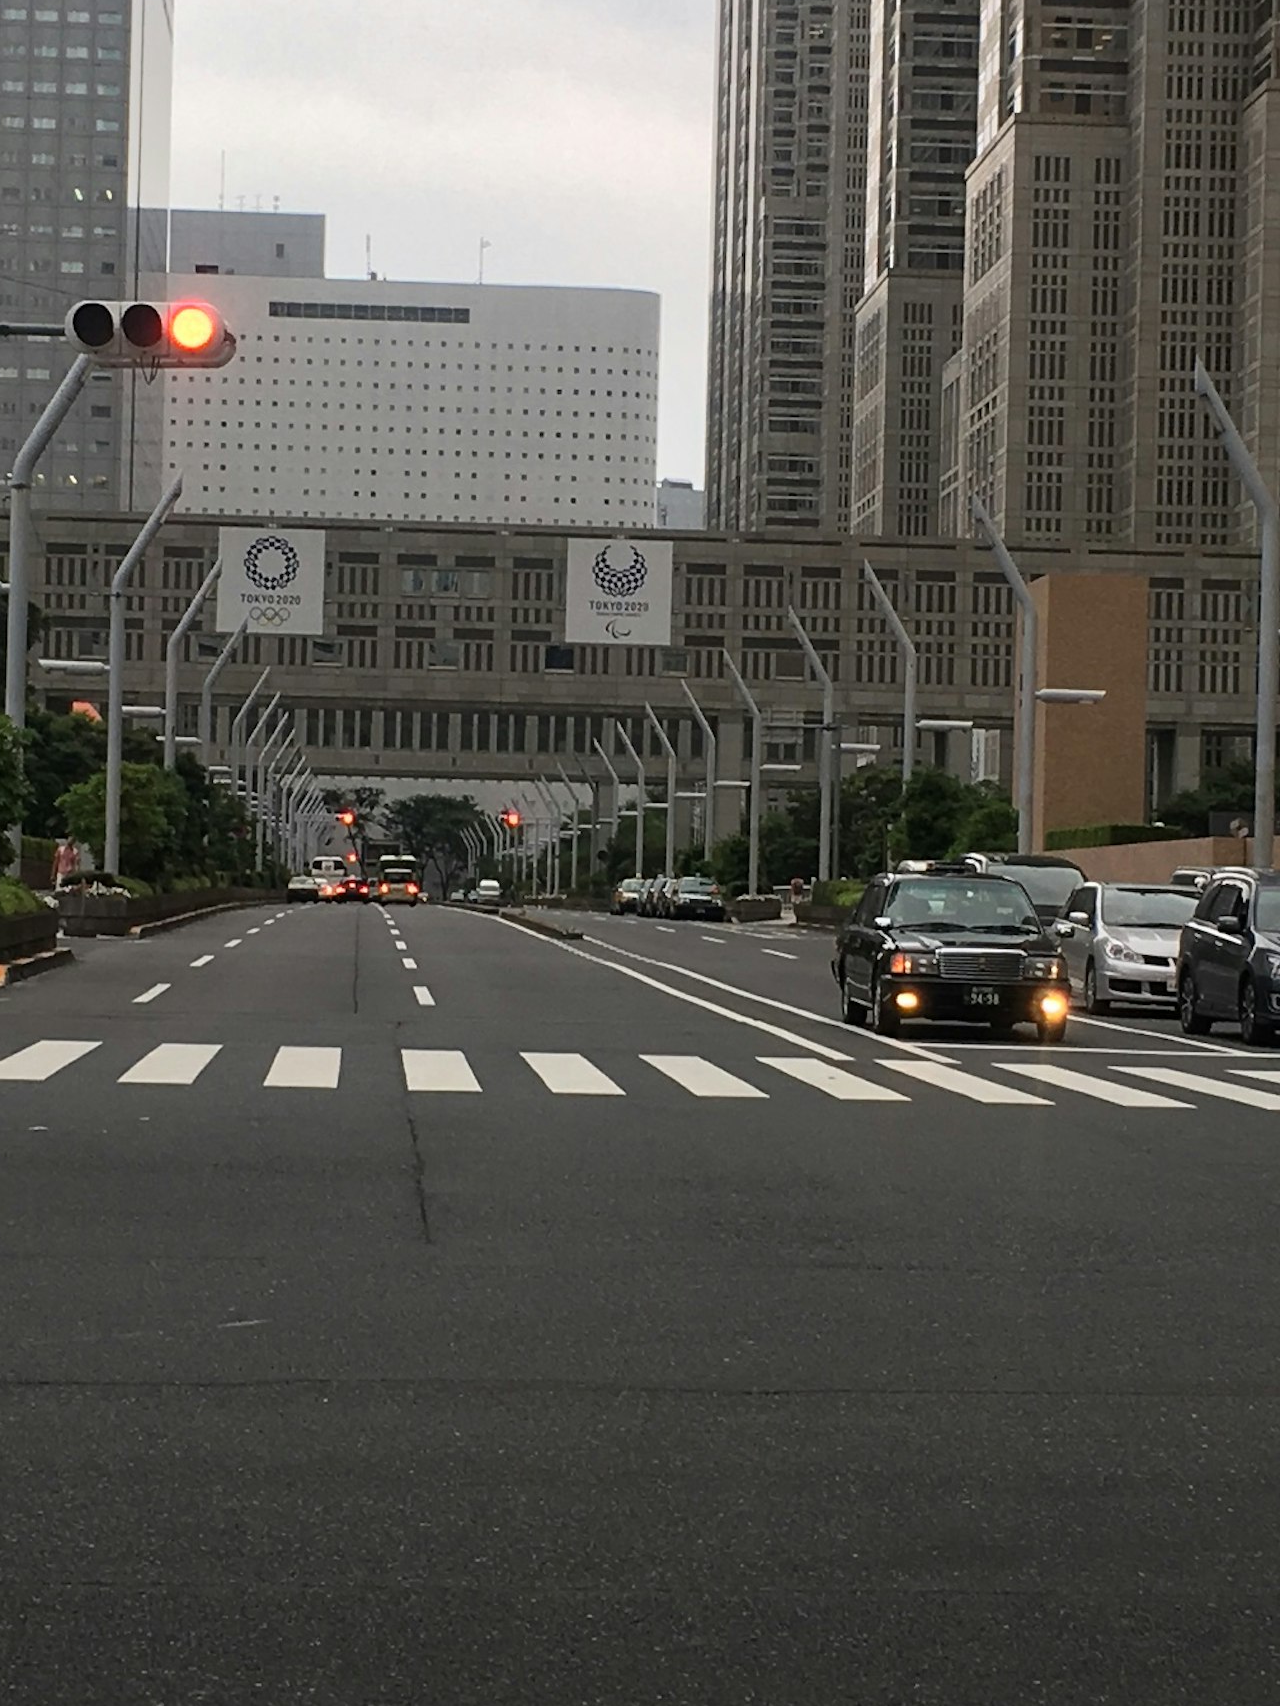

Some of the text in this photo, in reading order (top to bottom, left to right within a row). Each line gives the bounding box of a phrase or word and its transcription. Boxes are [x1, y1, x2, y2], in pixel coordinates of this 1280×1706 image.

[240, 593, 301, 606] TOKYO 2020
[589, 600, 649, 612] TOKYO 2020
